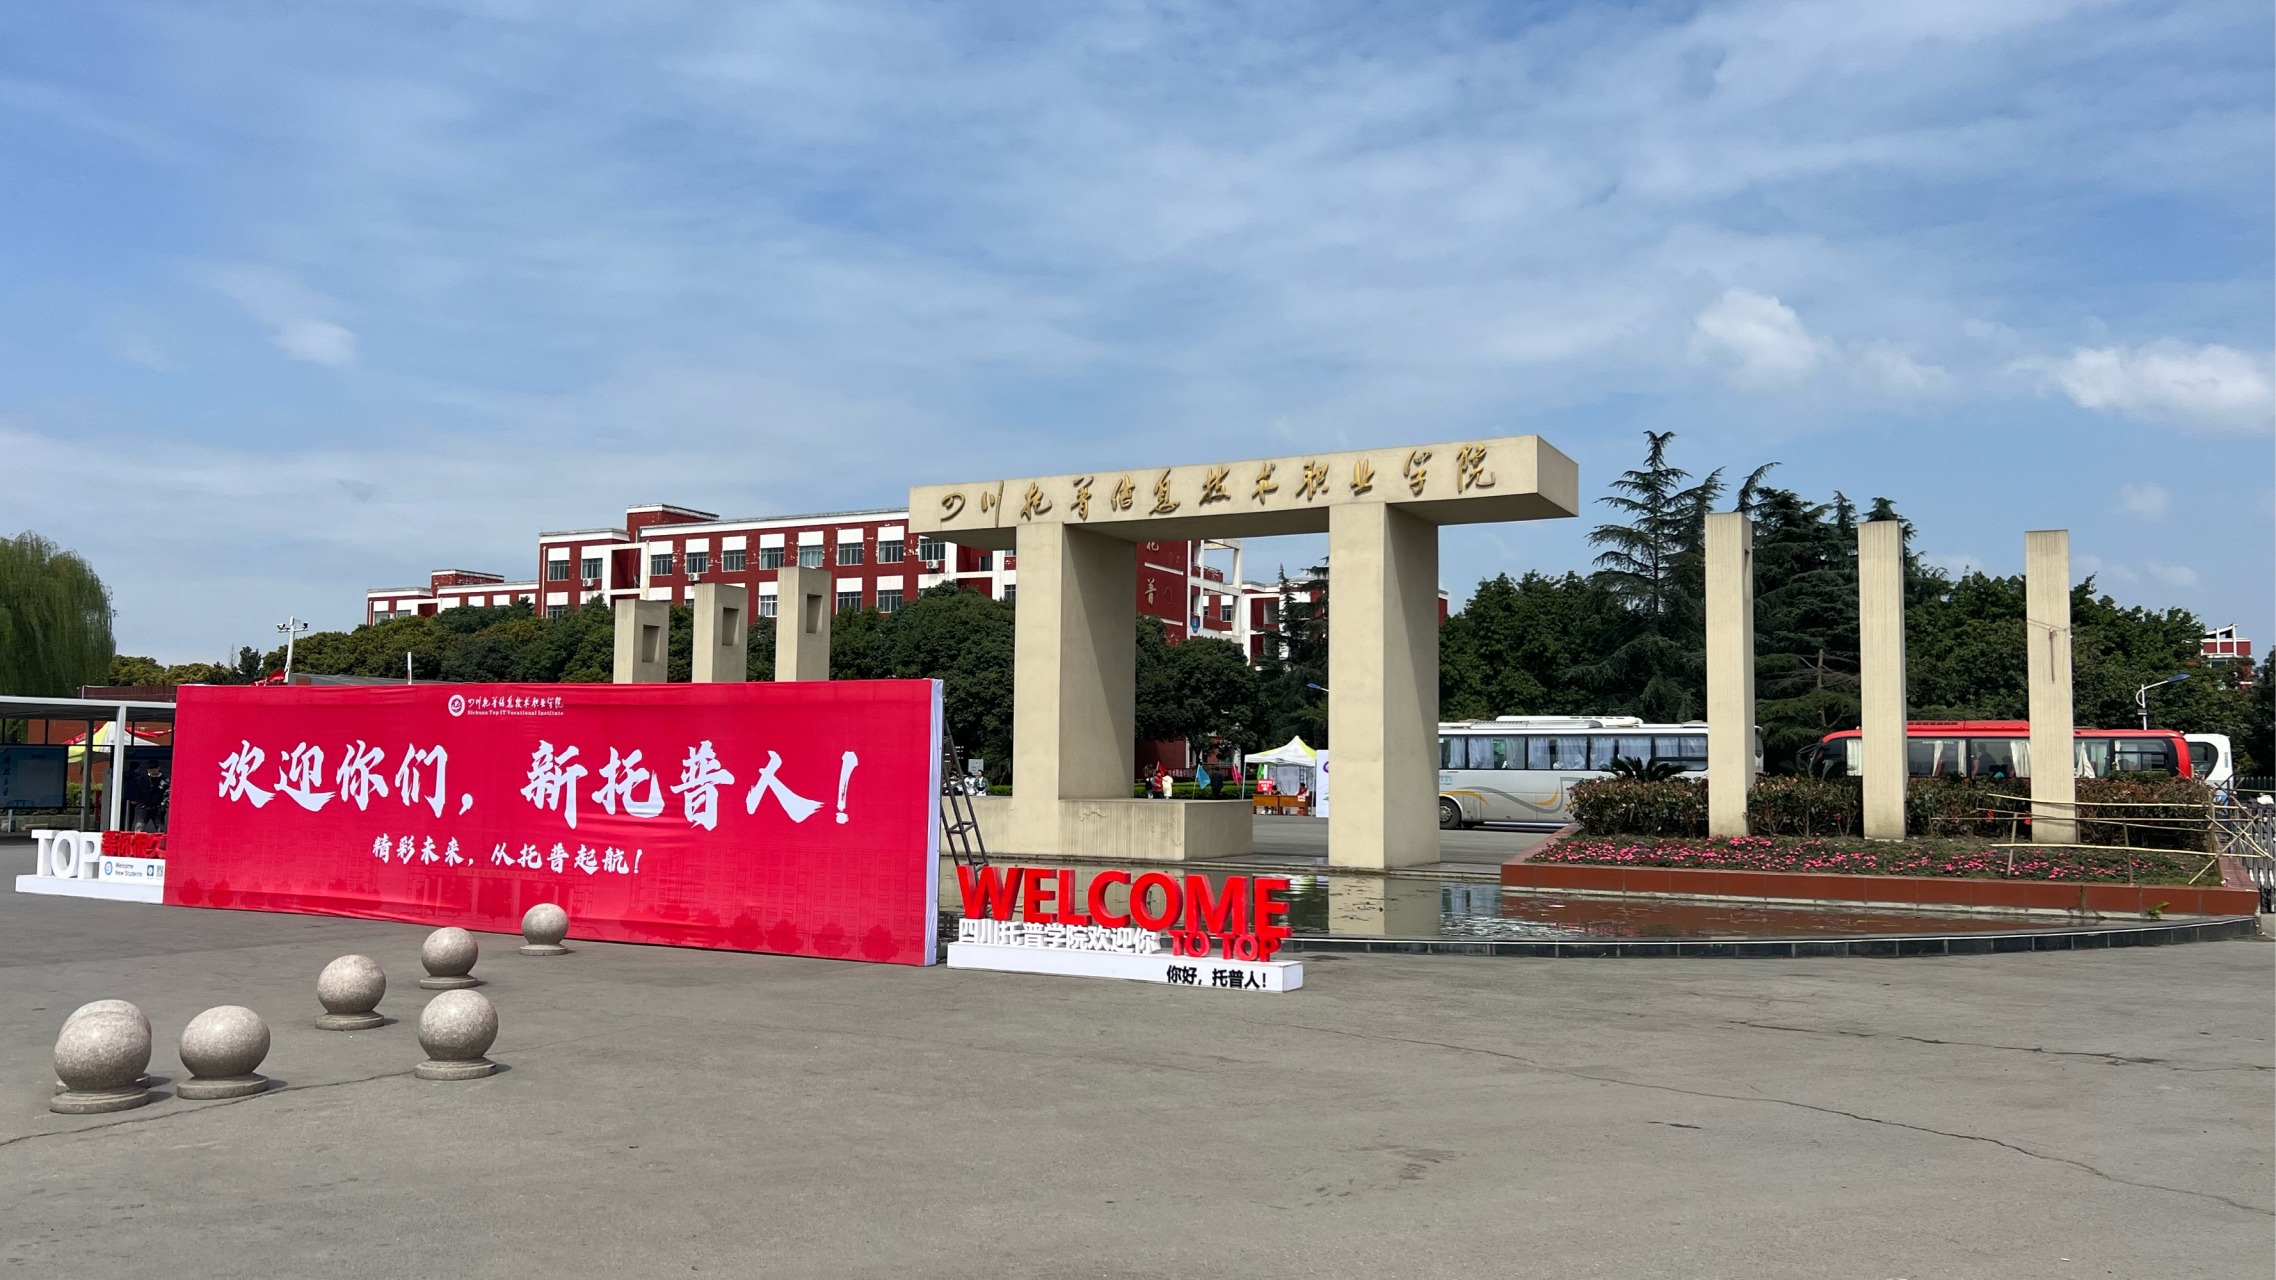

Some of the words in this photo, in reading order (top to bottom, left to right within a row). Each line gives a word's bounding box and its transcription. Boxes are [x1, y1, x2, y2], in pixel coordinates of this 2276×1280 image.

[941, 443, 1497, 528] 四川托普信息技术职业学院
[467, 695, 563, 709] 四川托普信息技术职业学院
[31, 829, 100, 880] TOP
[372, 833, 643, 875] 精彩未来，从托普起航！
[956, 864, 1292, 939] WELCOME
[958, 918, 1161, 955] 四川托普学院欢迎你
[1167, 930, 1212, 958] TO
[1216, 933, 1283, 962] TOP
[1166, 965, 1267, 989] 你好，托普人！
